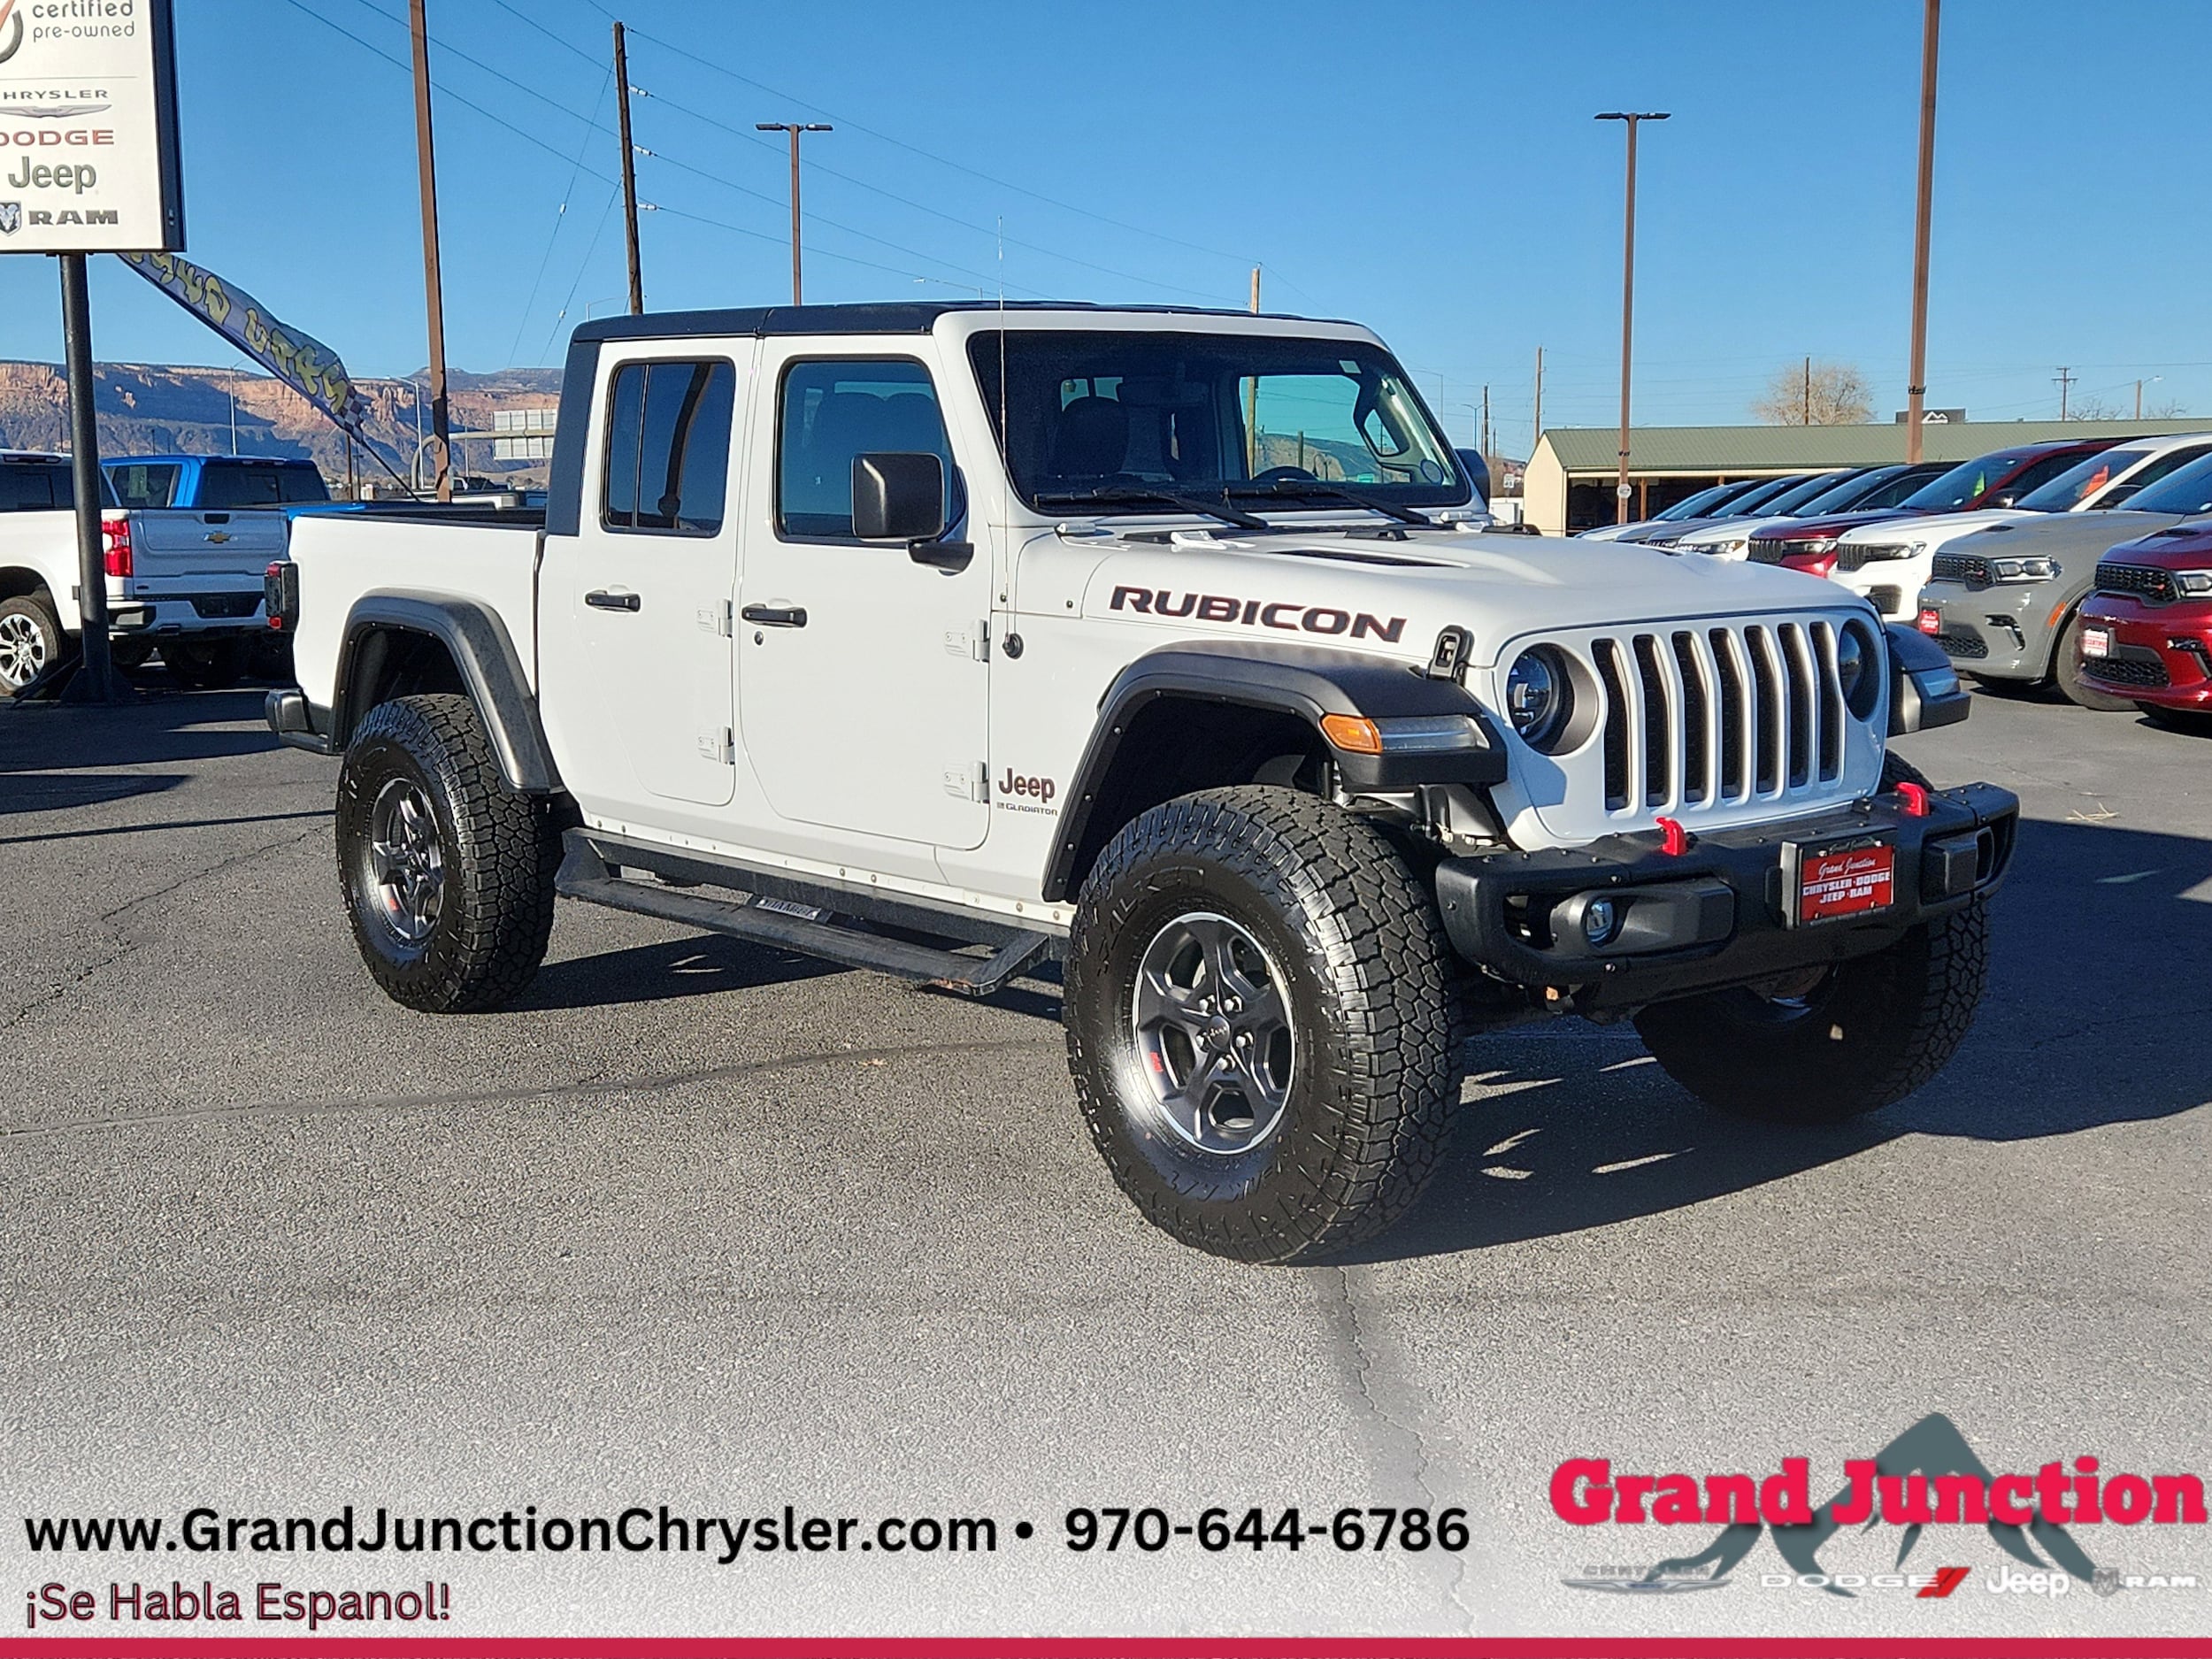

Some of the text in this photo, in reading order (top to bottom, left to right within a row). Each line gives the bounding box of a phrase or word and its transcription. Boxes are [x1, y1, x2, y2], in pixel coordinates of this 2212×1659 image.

[32, 0, 134, 18] certified
[33, 20, 135, 42] pre-owned
[3, 89, 109, 100] HRYSLER
[8, 156, 97, 195] Jeep
[28, 210, 119, 225] RAM
[127, 252, 232, 326] SED
[1109, 585, 1408, 643] RUBICON
[998, 767, 1056, 803] Jeep
[1005, 803, 1058, 816] GLADIATOR
[1818, 857, 1876, 880] Grand Junction
[1802, 872, 1890, 895] CHRYSLER DODGE
[1819, 886, 1872, 903] JEEP RAM
